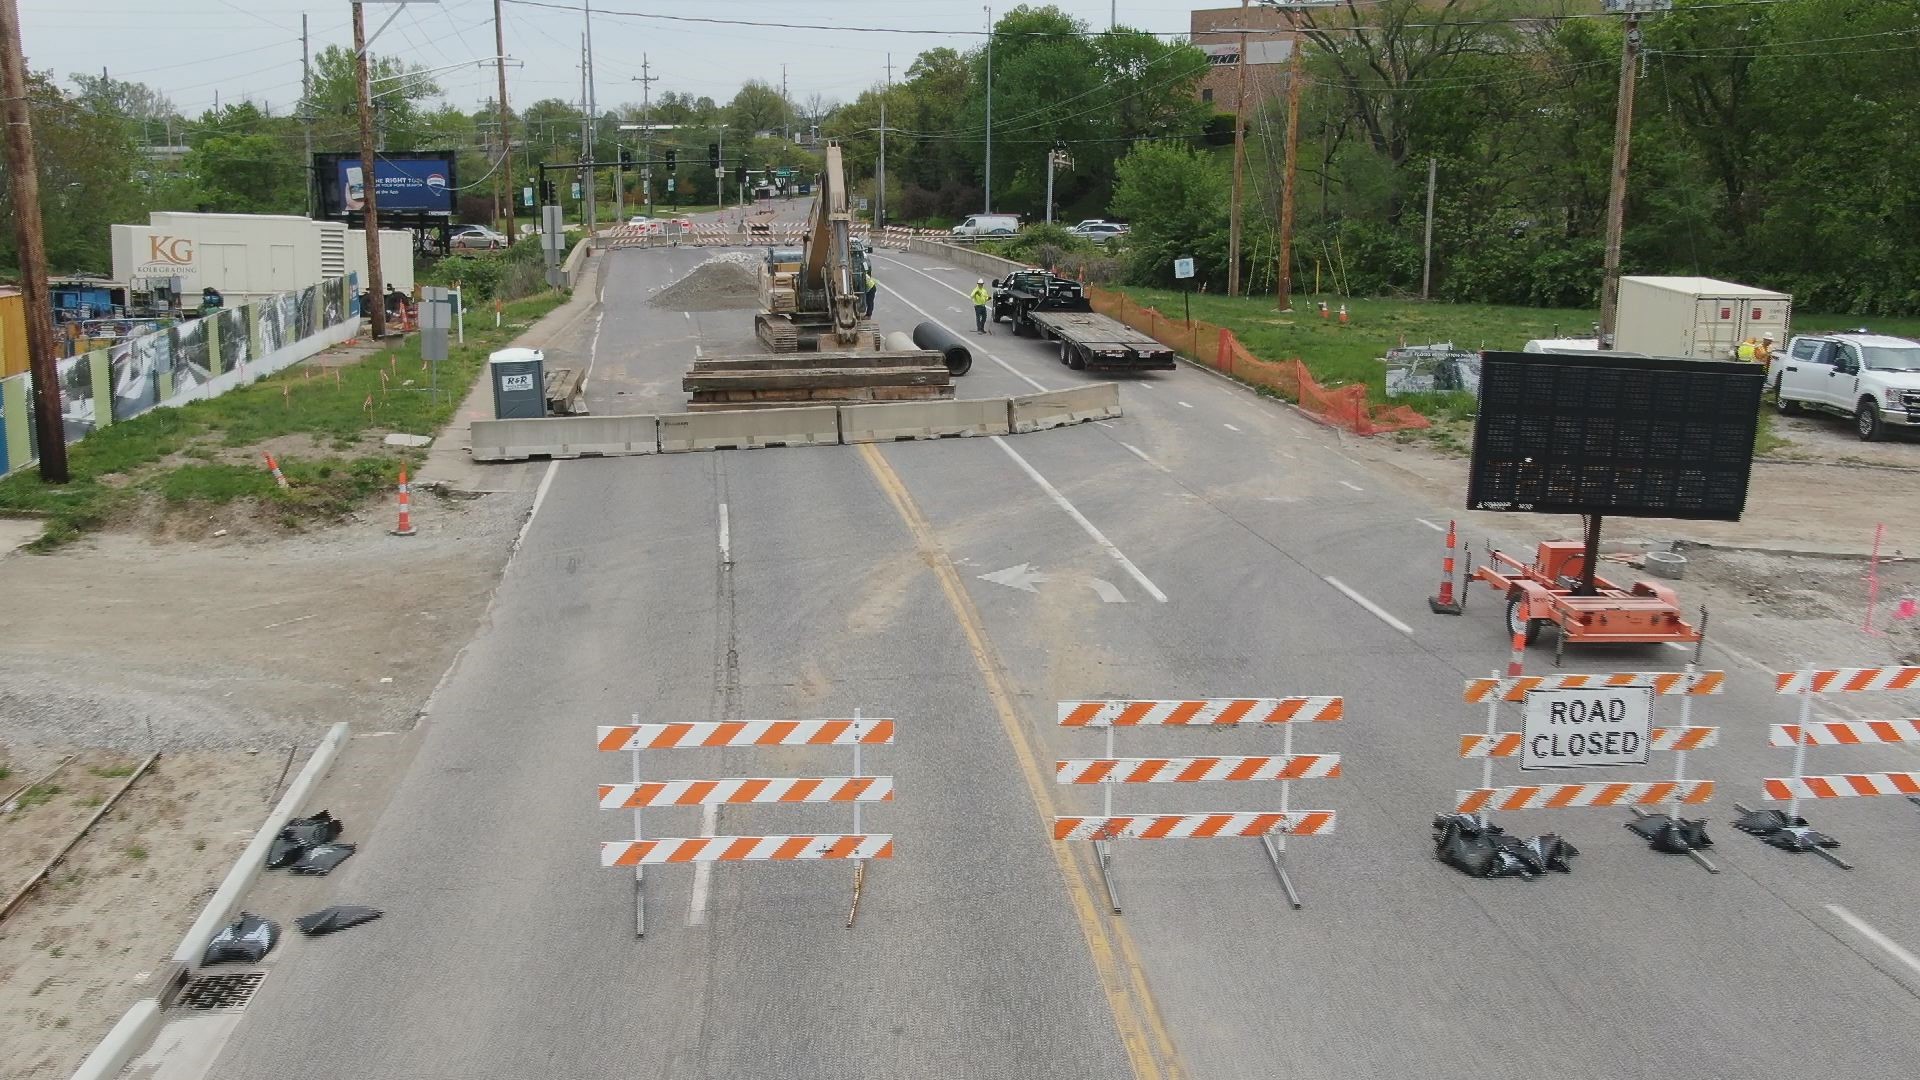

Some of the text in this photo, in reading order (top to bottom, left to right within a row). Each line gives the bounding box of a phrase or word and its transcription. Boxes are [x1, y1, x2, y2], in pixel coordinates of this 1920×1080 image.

[147, 235, 194, 265] KG
[1550, 697, 1626, 725] ROAD
[1531, 731, 1639, 759] CLOSED
